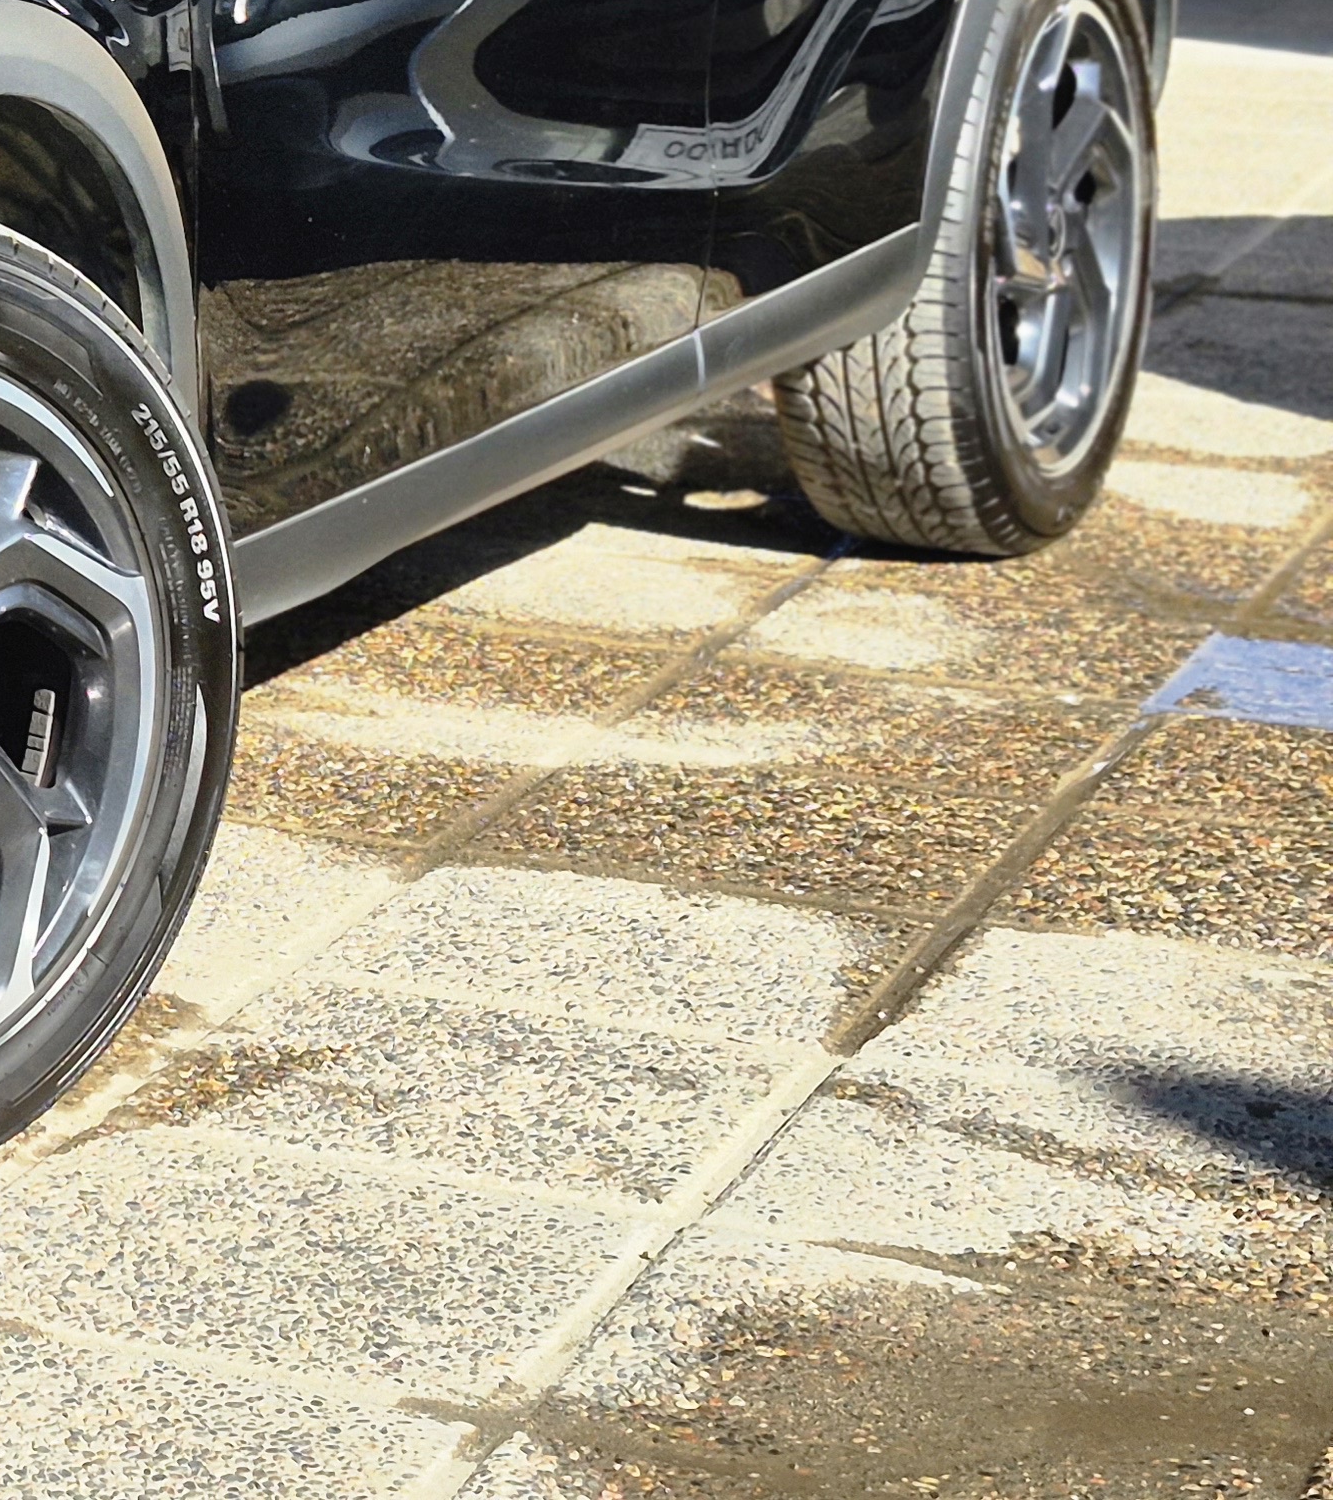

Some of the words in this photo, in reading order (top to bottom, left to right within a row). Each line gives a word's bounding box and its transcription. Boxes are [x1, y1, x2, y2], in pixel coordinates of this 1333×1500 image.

[130, 402, 190, 497] 215/55
[179, 495, 210, 556] R18
[196, 558, 221, 624] 95V
